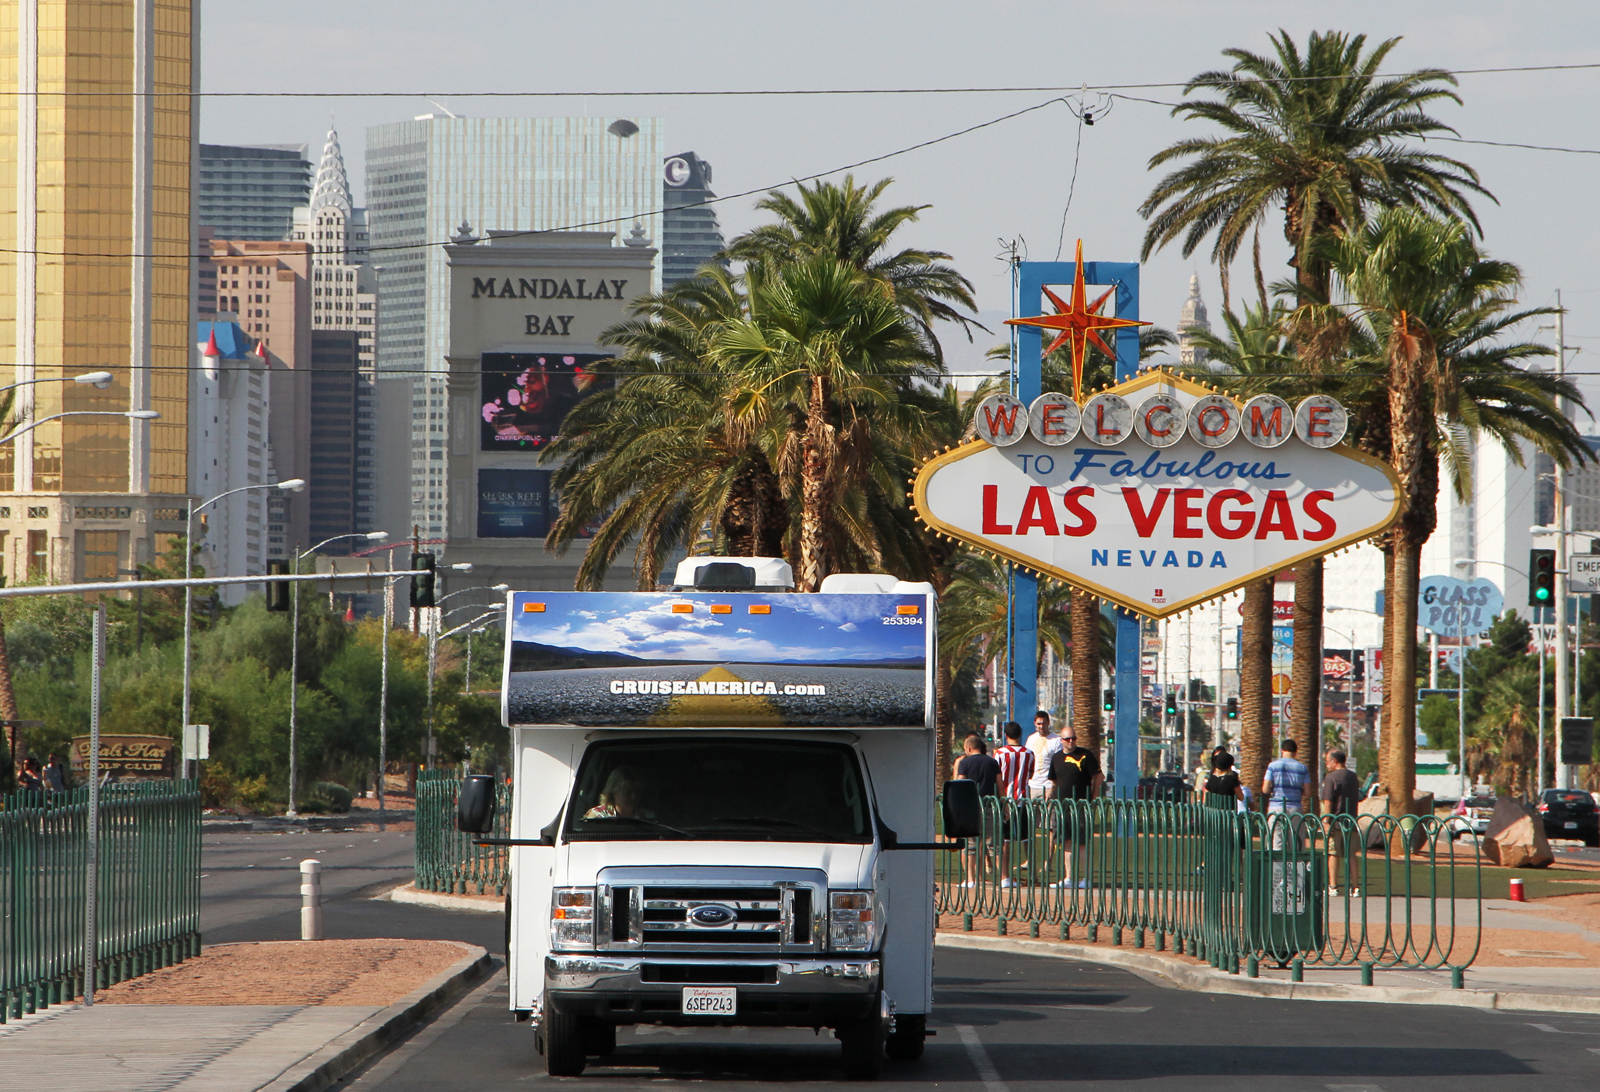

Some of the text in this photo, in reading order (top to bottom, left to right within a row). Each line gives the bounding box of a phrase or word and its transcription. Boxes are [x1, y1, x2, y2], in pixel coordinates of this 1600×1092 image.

[471, 277, 628, 300] MANDALAY
[524, 314, 575, 336] BAY
[983, 404, 1334, 438] WELCOME
[1017, 448, 1292, 481] TO Fabulous
[482, 492, 541, 501] SHARK REEF
[981, 484, 1337, 541] LAS VEGAS
[1091, 549, 1228, 568] NEVADA
[1423, 585, 1491, 606] GLASS
[882, 616, 923, 626] 253394
[1429, 606, 1483, 627] POOL
[1324, 663, 1346, 671] GAS
[609, 680, 826, 696] CRUISEAMERICA.com
[125, 743, 167, 757] Hai
[124, 762, 162, 770] CLUB
[702, 910, 723, 920] Ford
[693, 989, 725, 998] California
[686, 997, 733, 1011] 6SEP243
